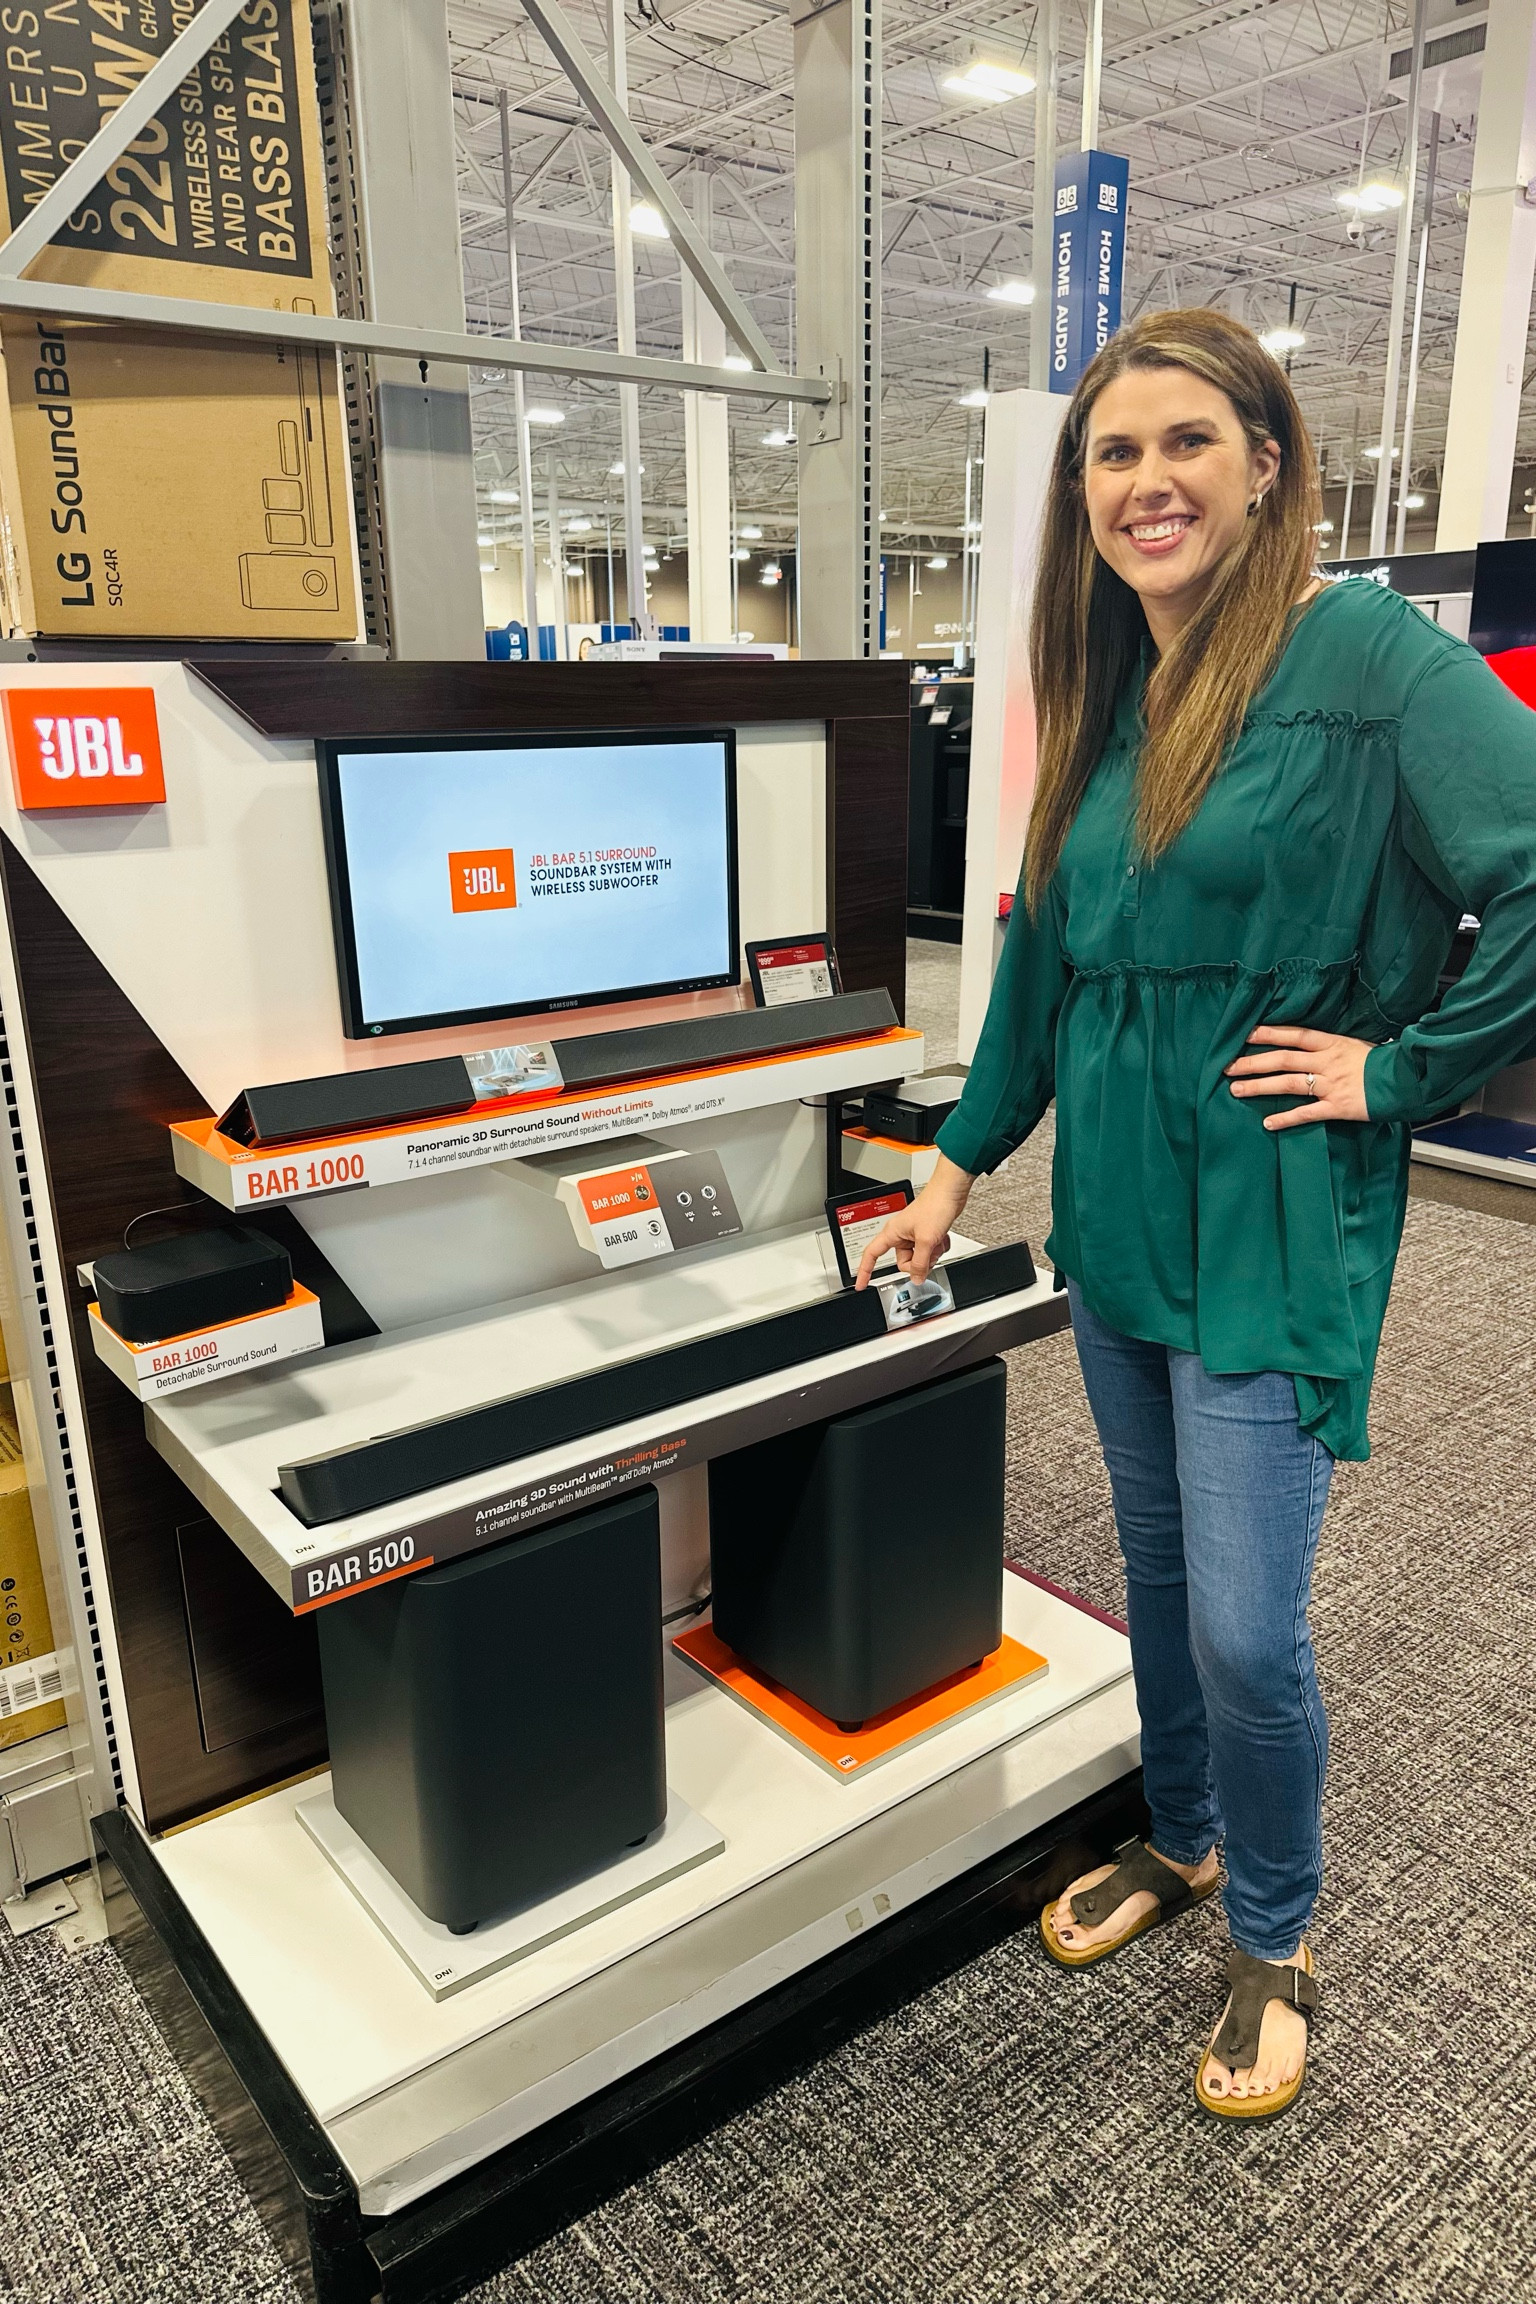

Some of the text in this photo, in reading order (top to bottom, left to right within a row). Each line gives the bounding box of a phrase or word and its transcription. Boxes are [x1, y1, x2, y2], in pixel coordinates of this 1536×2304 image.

[2, 7, 56, 206] MMERS
[240, 0, 297, 261] BASS BLAS
[209, 29, 249, 255] AND REAR SPE
[183, 119, 217, 249] WIRELESS
[1054, 231, 1072, 372] HOME AUDIO
[1095, 230, 1112, 353] HOME AUDI
[34, 322, 95, 607] LG Sound Bar
[103, 548, 123, 607] SQC4R
[33, 716, 144, 779] JBL
[463, 866, 506, 896] JBL
[530, 846, 657, 867] JBL BAR 5.1 SURROUND
[530, 858, 672, 881] SOUNDBAR SYSTEM WITH
[531, 874, 659, 897] WIRELESS SUBWOOFER
[549, 1000, 578, 1010] SAMSUNG
[407, 1099, 653, 1155] Panoramic 3D Surround Sound Without Limits
[408, 1159, 427, 1169] 7.1.4
[429, 1151, 457, 1166] channel
[458, 1145, 492, 1160] soundbar
[493, 1142, 509, 1153] with
[509, 1132, 546, 1149] detachable
[547, 1128, 579, 1142] surround
[580, 1122, 611, 1137] speakers,
[652, 1109, 669, 1121] Dolby
[694, 1101, 705, 1112] and
[247, 1154, 365, 1200] BAR 1000
[591, 1193, 631, 1210] BAR 1000
[604, 1230, 639, 1248] BAR 500
[152, 1352, 182, 1373] BAR
[184, 1341, 218, 1364] 1000
[156, 1364, 206, 1390] Detachable
[207, 1352, 250, 1376] Surround
[250, 1344, 278, 1360] Sound
[475, 1438, 687, 1523] Amazing 3D Sound with Thrilling Bass
[475, 1523, 489, 1537] 5.1
[489, 1512, 520, 1531] channel
[520, 1500, 557, 1520] soundbar
[557, 1491, 574, 1506] with
[619, 1471, 633, 1484] and
[633, 1463, 652, 1479] Dolby
[295, 1544, 316, 1554] DNI
[307, 1535, 415, 1598] BAR 500
[840, 1755, 855, 1767] DNI
[434, 1968, 453, 1980] DNI
